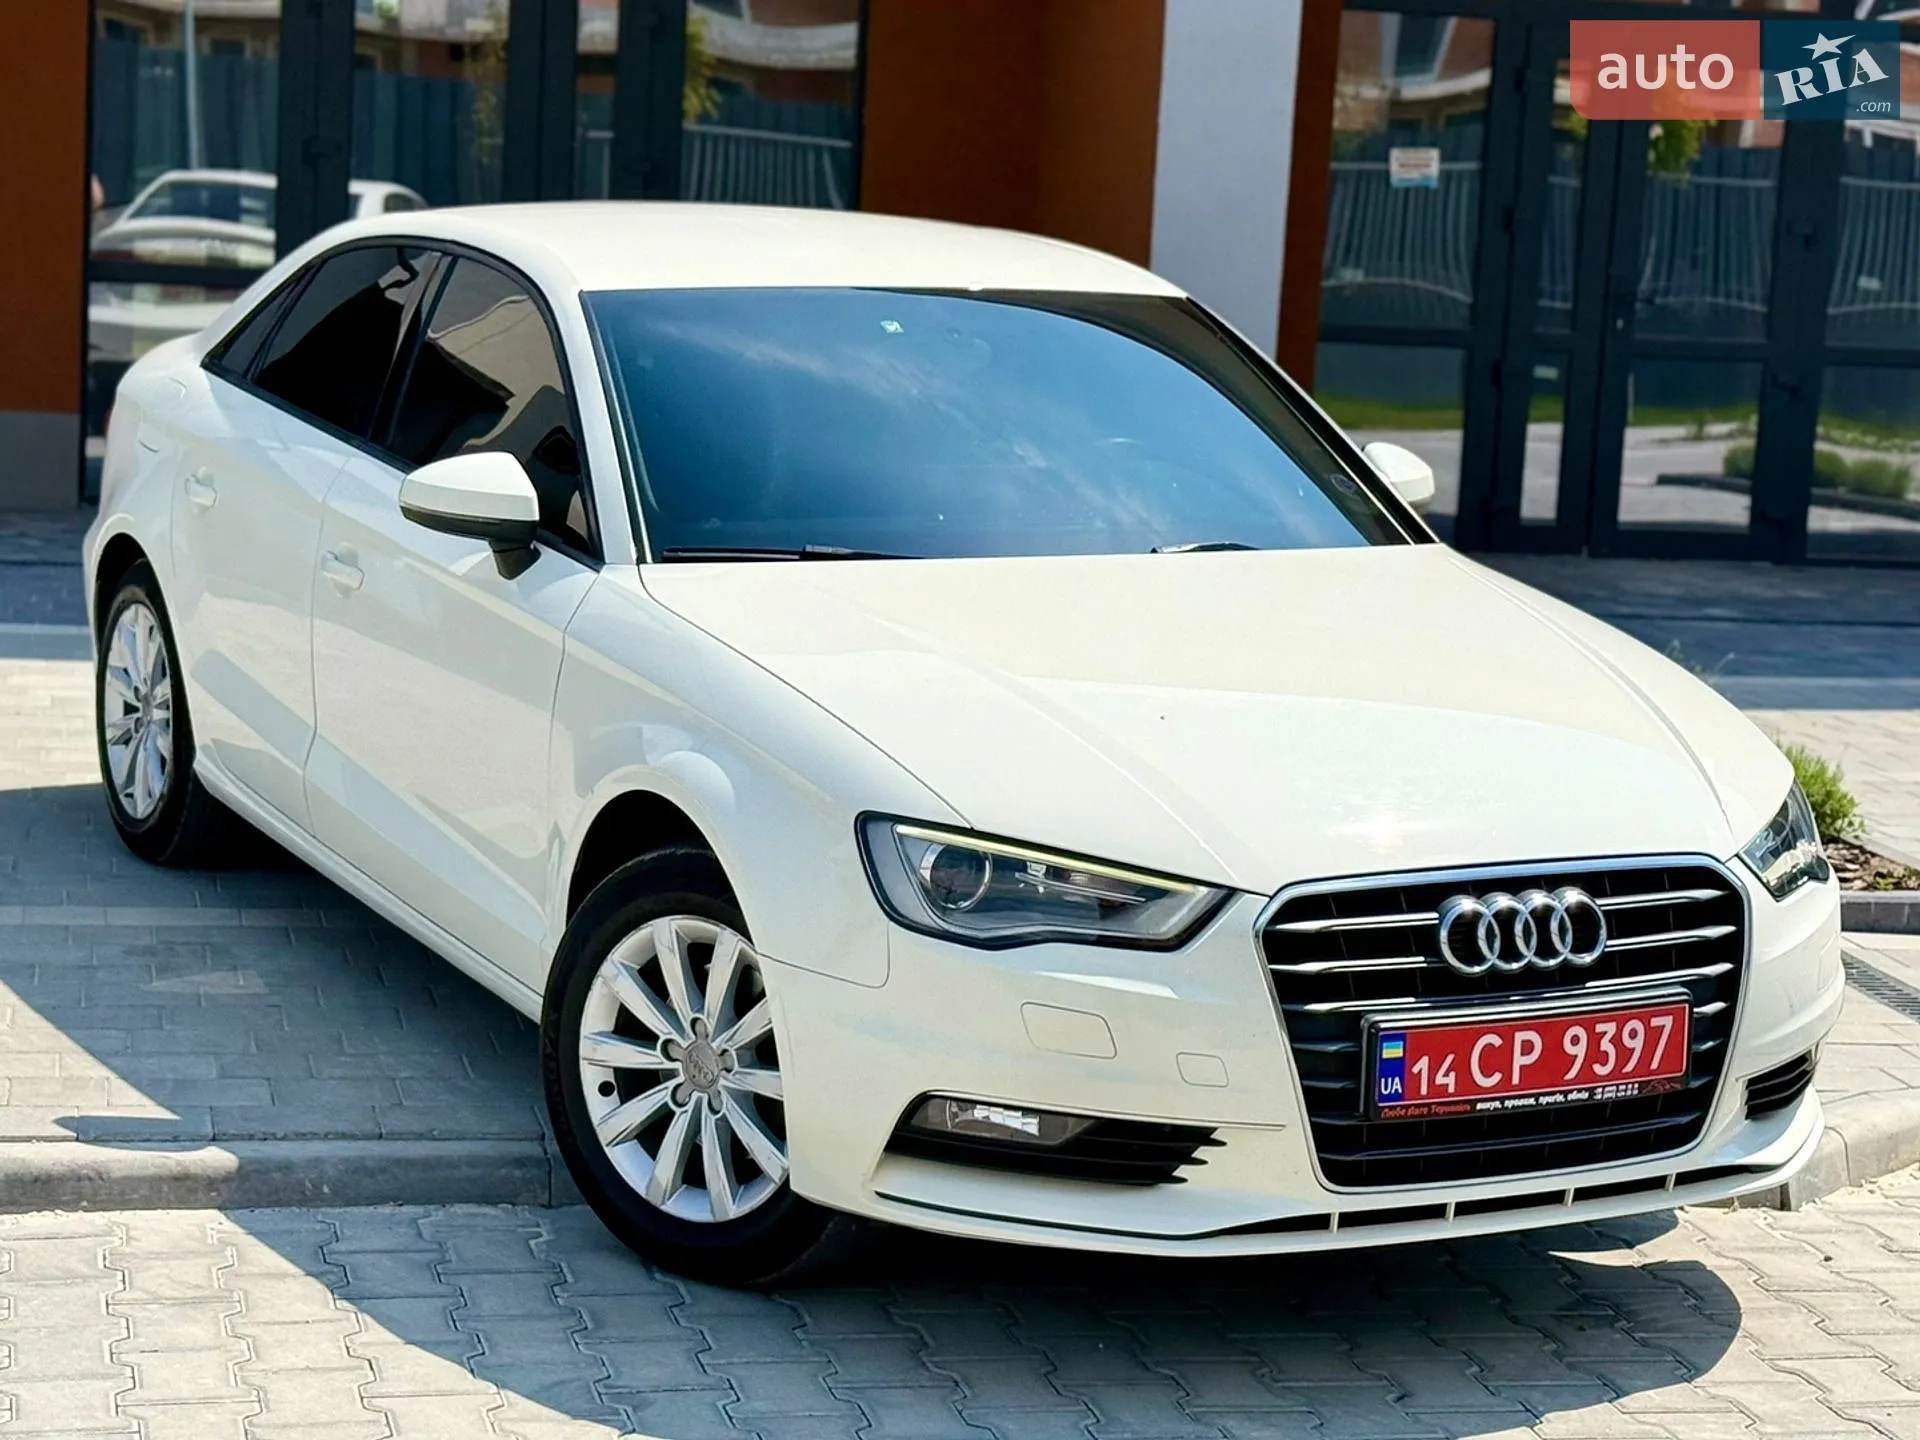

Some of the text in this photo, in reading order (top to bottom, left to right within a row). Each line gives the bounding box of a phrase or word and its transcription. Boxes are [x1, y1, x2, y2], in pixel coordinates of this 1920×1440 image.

[1411, 1014, 1674, 1096] 14 CP 9397
[1381, 1076, 1402, 1095] UA
